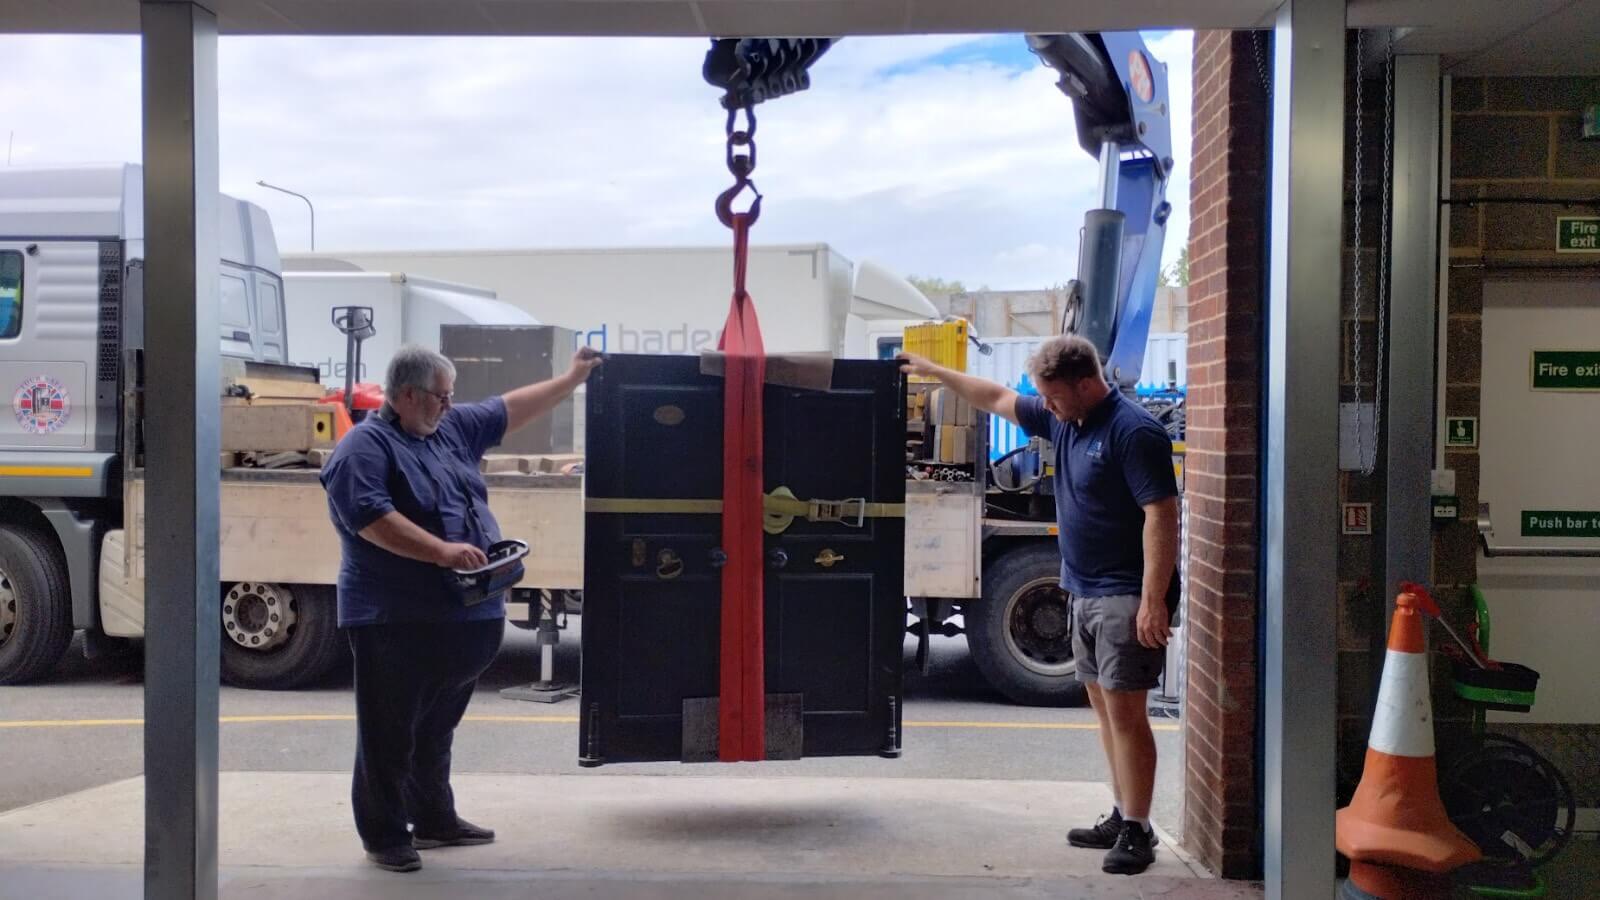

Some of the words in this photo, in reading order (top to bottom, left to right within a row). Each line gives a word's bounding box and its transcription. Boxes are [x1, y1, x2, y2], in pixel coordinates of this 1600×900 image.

[1571, 222, 1598, 234] Fire
[1570, 235, 1596, 247] exit
[1539, 363, 1568, 377] Fire
[1529, 516, 1563, 529] Push
[1566, 516, 1588, 529] bar
